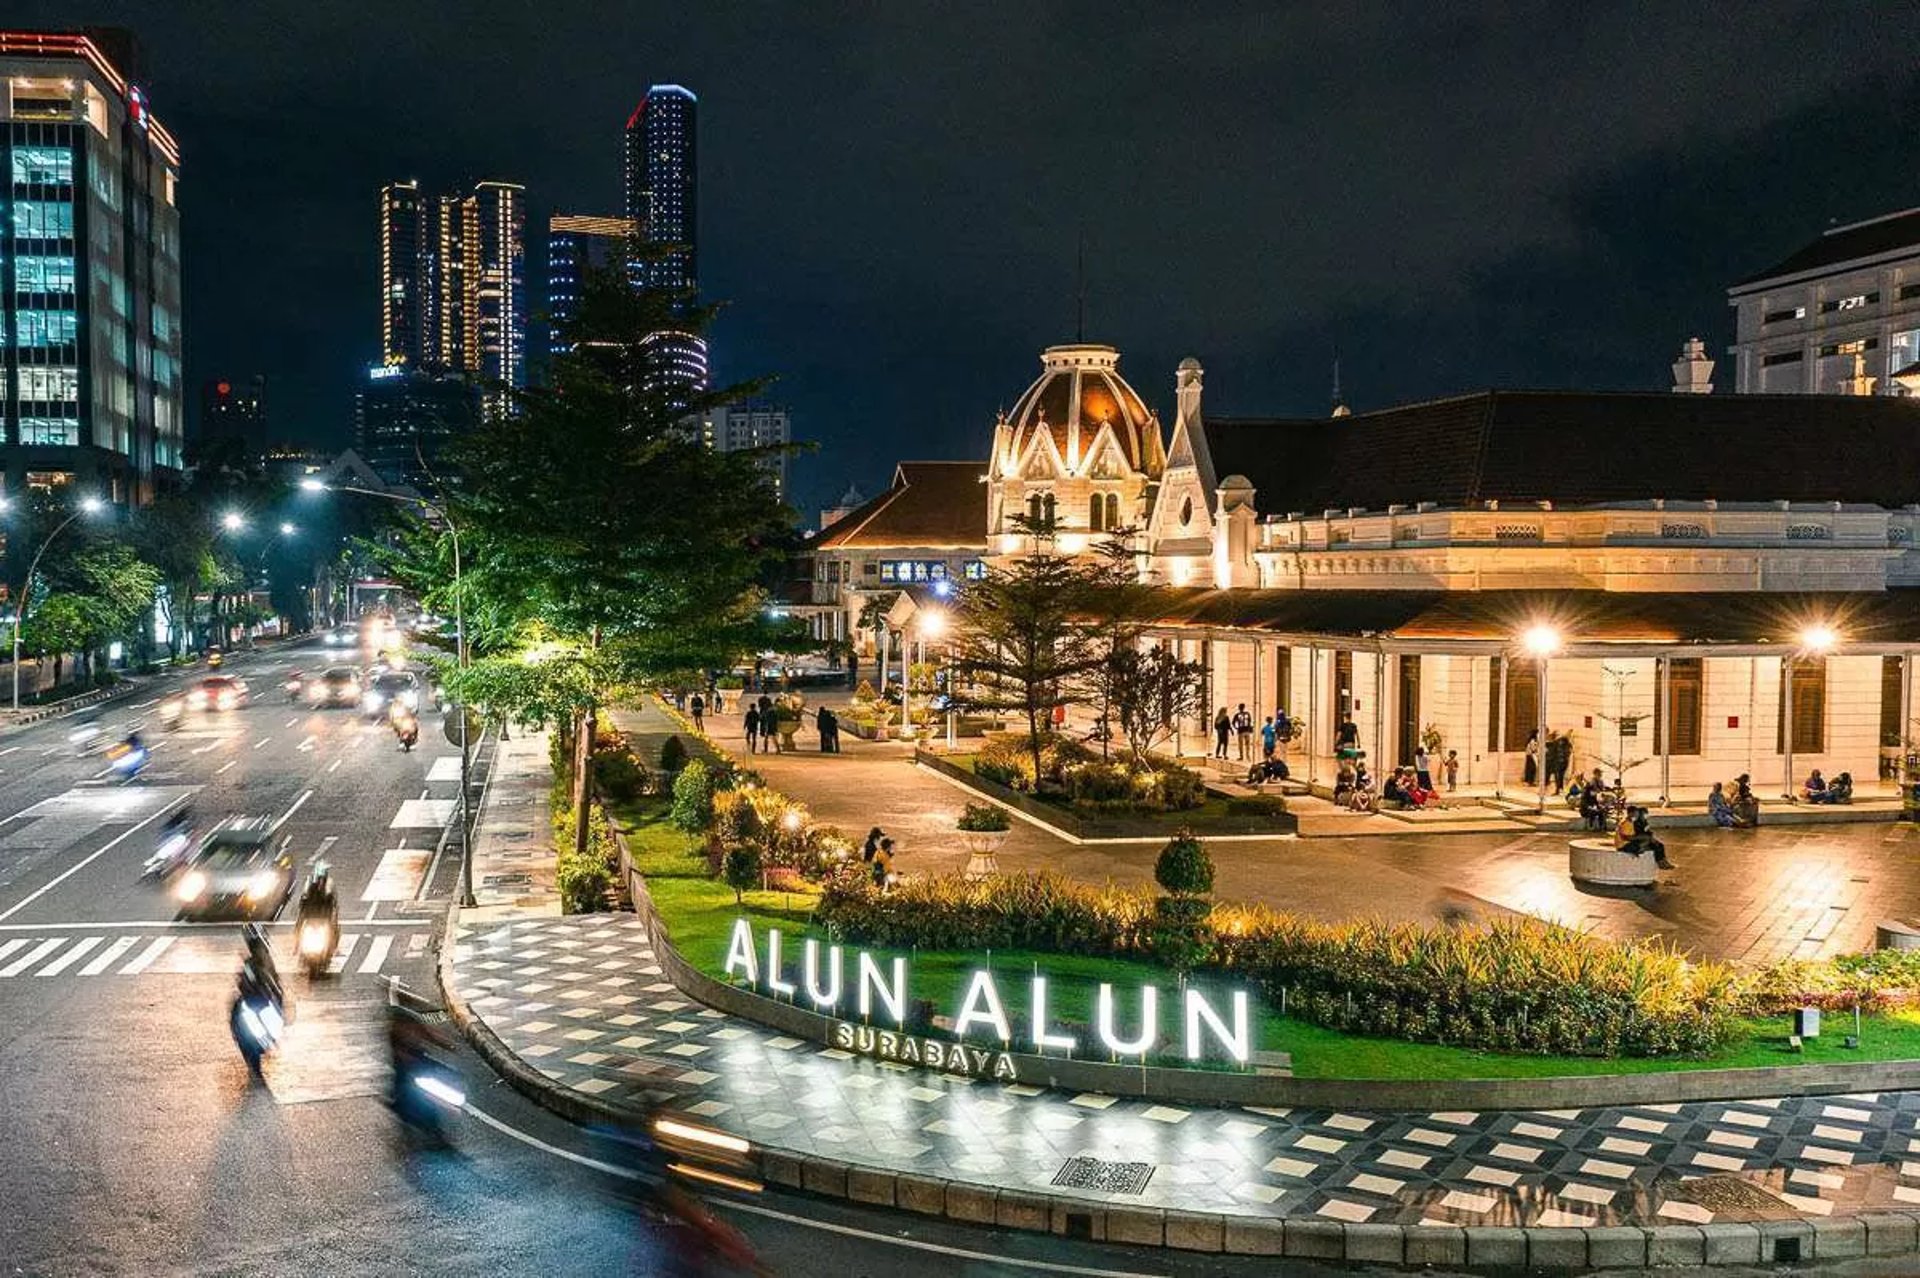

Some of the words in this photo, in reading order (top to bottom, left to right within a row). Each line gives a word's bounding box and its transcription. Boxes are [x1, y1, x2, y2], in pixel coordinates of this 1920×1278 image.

[725, 918, 907, 1021] ALUN
[955, 970, 1248, 1060] ALUN
[836, 1023, 1017, 1079] SURABAYA
